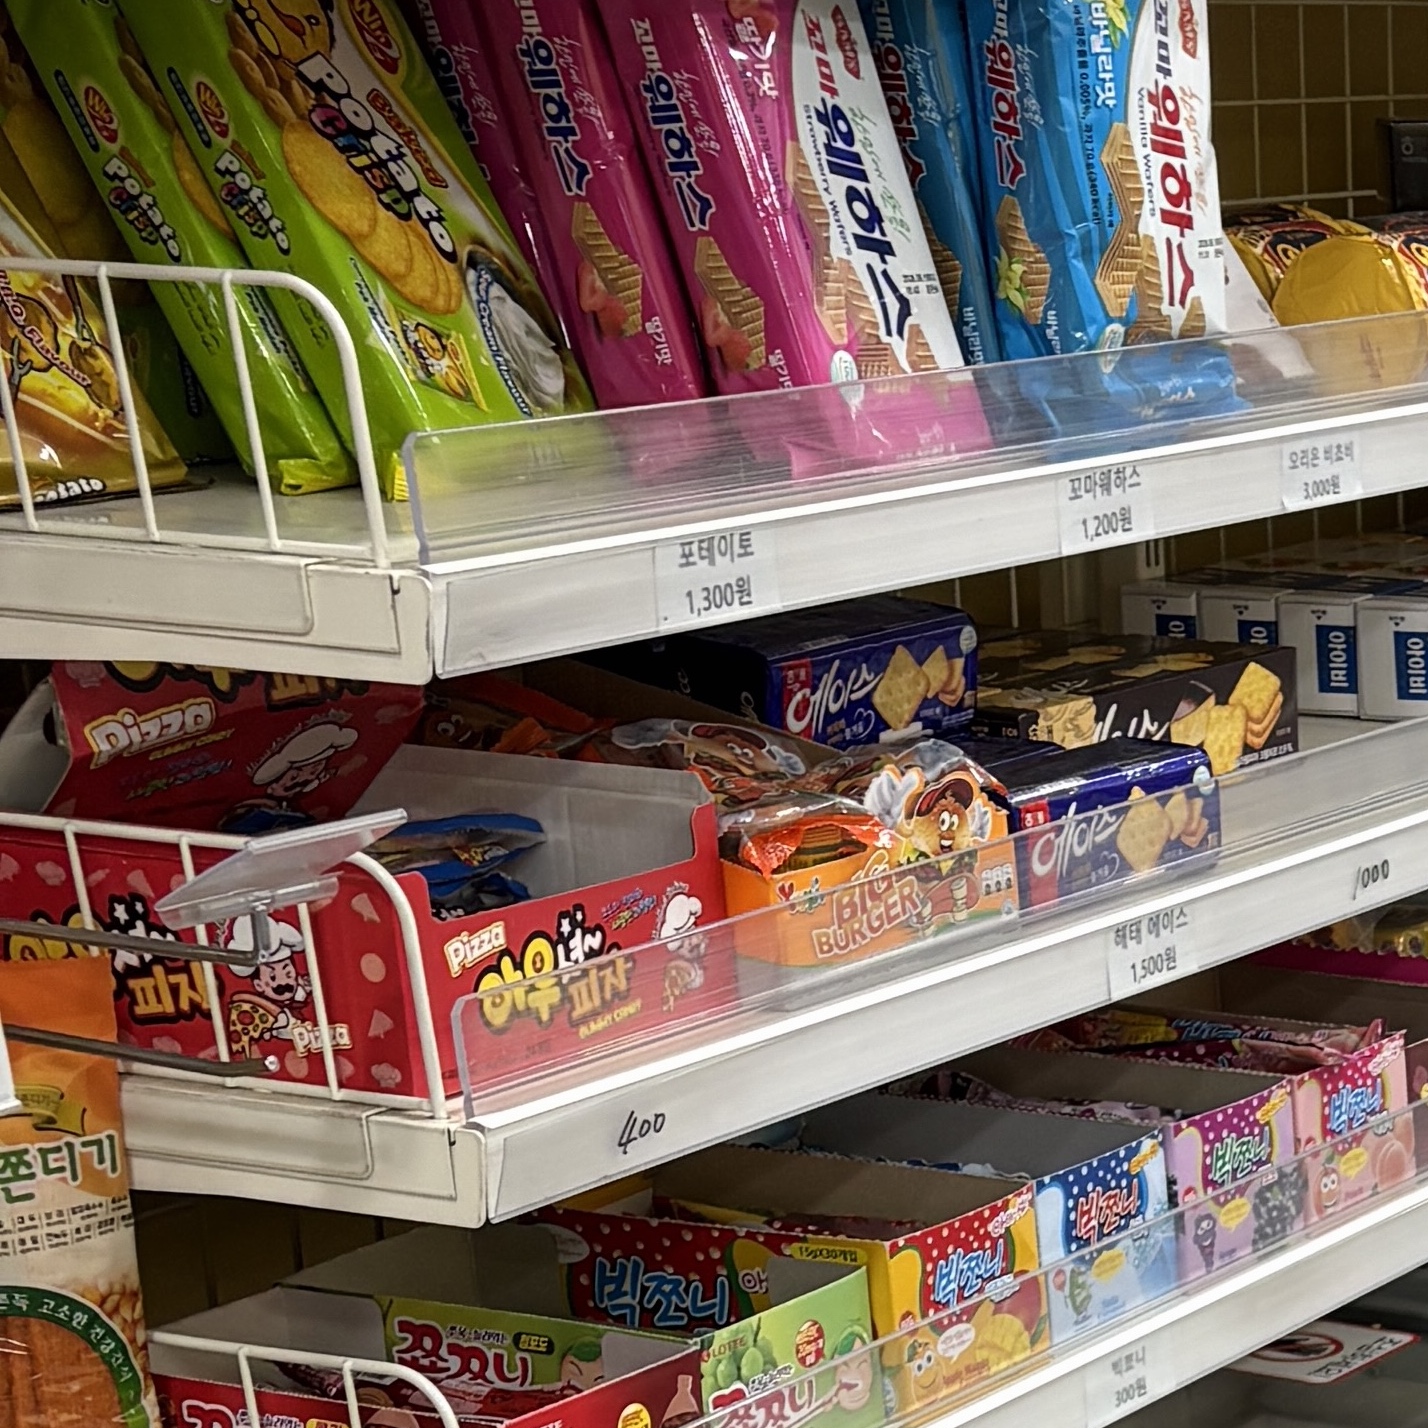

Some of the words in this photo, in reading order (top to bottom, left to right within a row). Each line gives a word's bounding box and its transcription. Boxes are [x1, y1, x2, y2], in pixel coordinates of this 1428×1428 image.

[516, 36, 591, 196] 웨하스
[984, 40, 1026, 190] 웨하스
[298, 50, 458, 264] Potato
[308, 102, 413, 222] Crisp
[640, 71, 715, 231] 웨하스
[103, 153, 182, 264] Potato
[214, 150, 292, 255] Potato
[814, 98, 912, 342] 웨하스
[1148, 77, 1195, 309] 웨하스
[1067, 467, 1142, 502] 꼬마웨하스
[1288, 447, 1320, 471] 오리온
[1303, 475, 1341, 501] 3,000원
[678, 532, 756, 569] 포테이토
[1081, 507, 1133, 541] 1,200원
[684, 578, 754, 616] 1,300원
[785, 660, 880, 738] 에이스
[90, 697, 214, 768] Pizza
[1032, 803, 1122, 878] 에이스
[446, 923, 506, 974] Pizza
[812, 878, 922, 958] BURGER
[1114, 920, 1143, 950] 해태
[1147, 906, 1189, 939] 에이스
[1130, 946, 1178, 982] 1,500원
[292, 1024, 351, 1049] Pizza
[616, 1109, 667, 1154] 400
[711, 1336, 747, 1360] LOTTE
[1115, 1376, 1148, 1408] 300원
